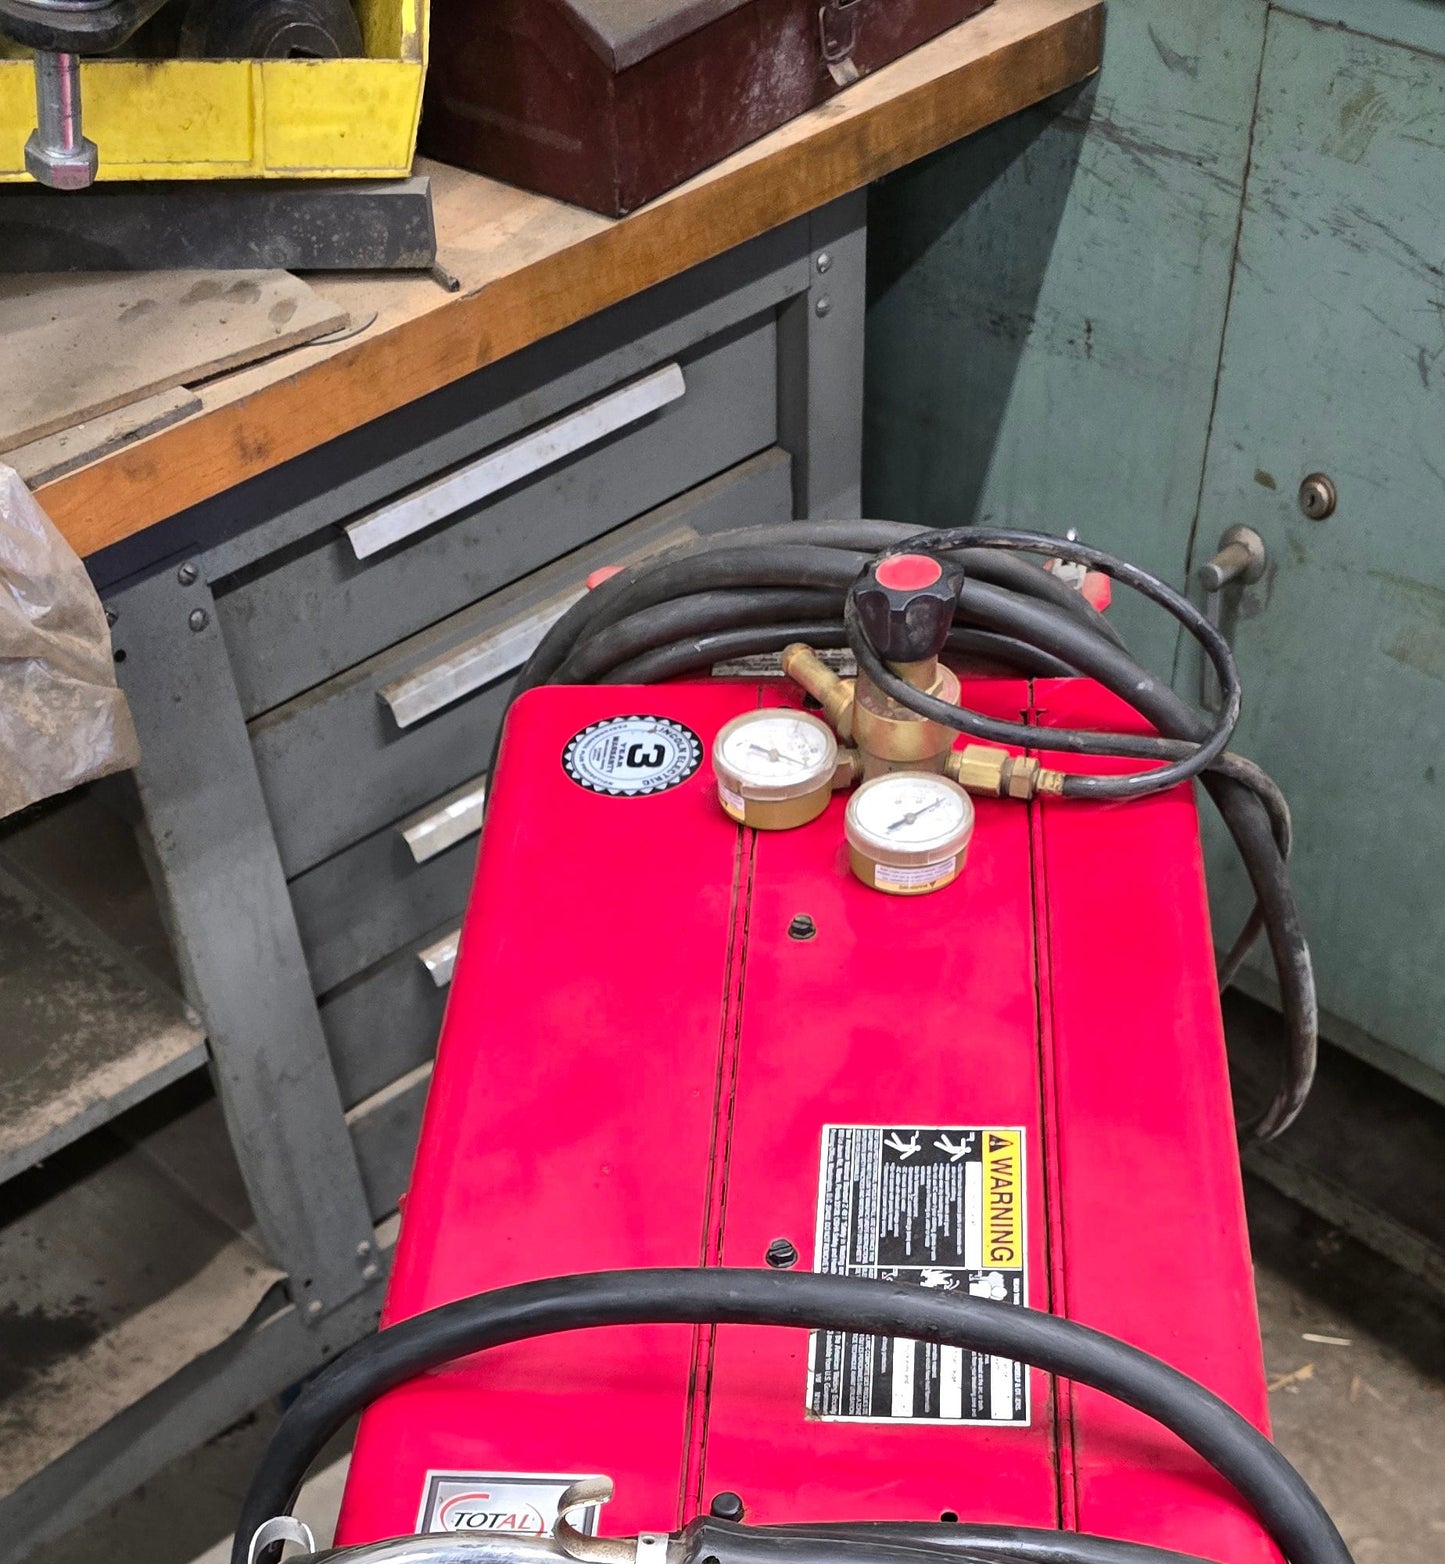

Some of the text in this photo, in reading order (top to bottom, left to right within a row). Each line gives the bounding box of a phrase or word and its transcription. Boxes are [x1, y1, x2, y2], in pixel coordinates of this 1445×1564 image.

[616, 742, 627, 768] YEAR
[626, 743, 666, 768] 3
[990, 1157, 1014, 1262] WARNING
[454, 1512, 532, 1530] TOTAL
